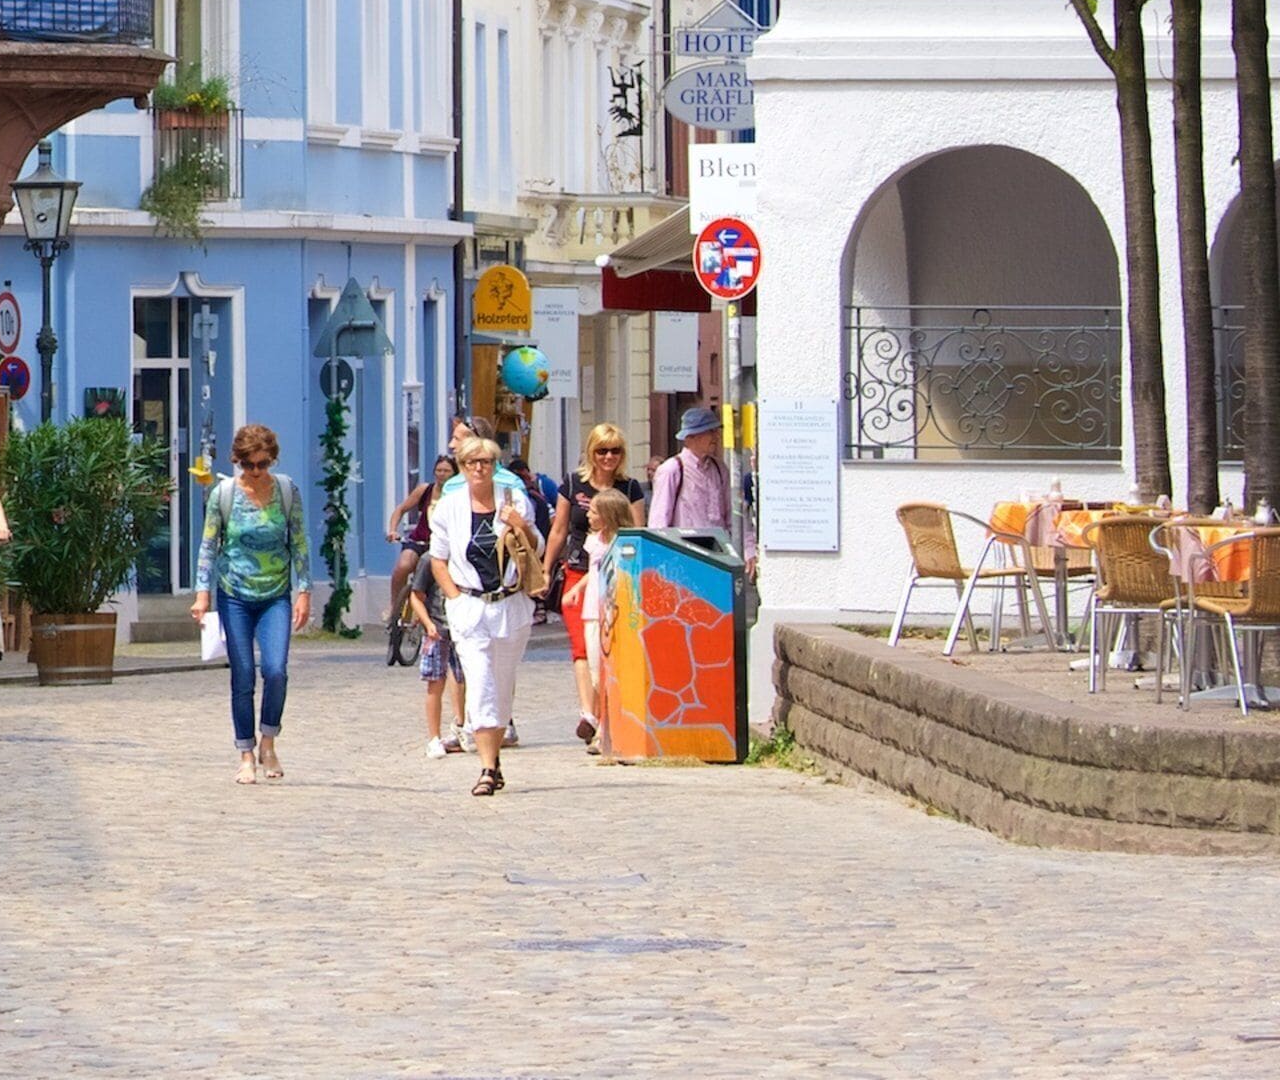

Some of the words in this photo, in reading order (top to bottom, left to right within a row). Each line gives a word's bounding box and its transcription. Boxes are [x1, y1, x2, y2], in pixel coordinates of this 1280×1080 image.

[684, 34, 753, 52] HOTE
[680, 88, 754, 105] GRÄFL
[696, 107, 737, 122] HOF
[476, 312, 528, 325] Holzpferd
